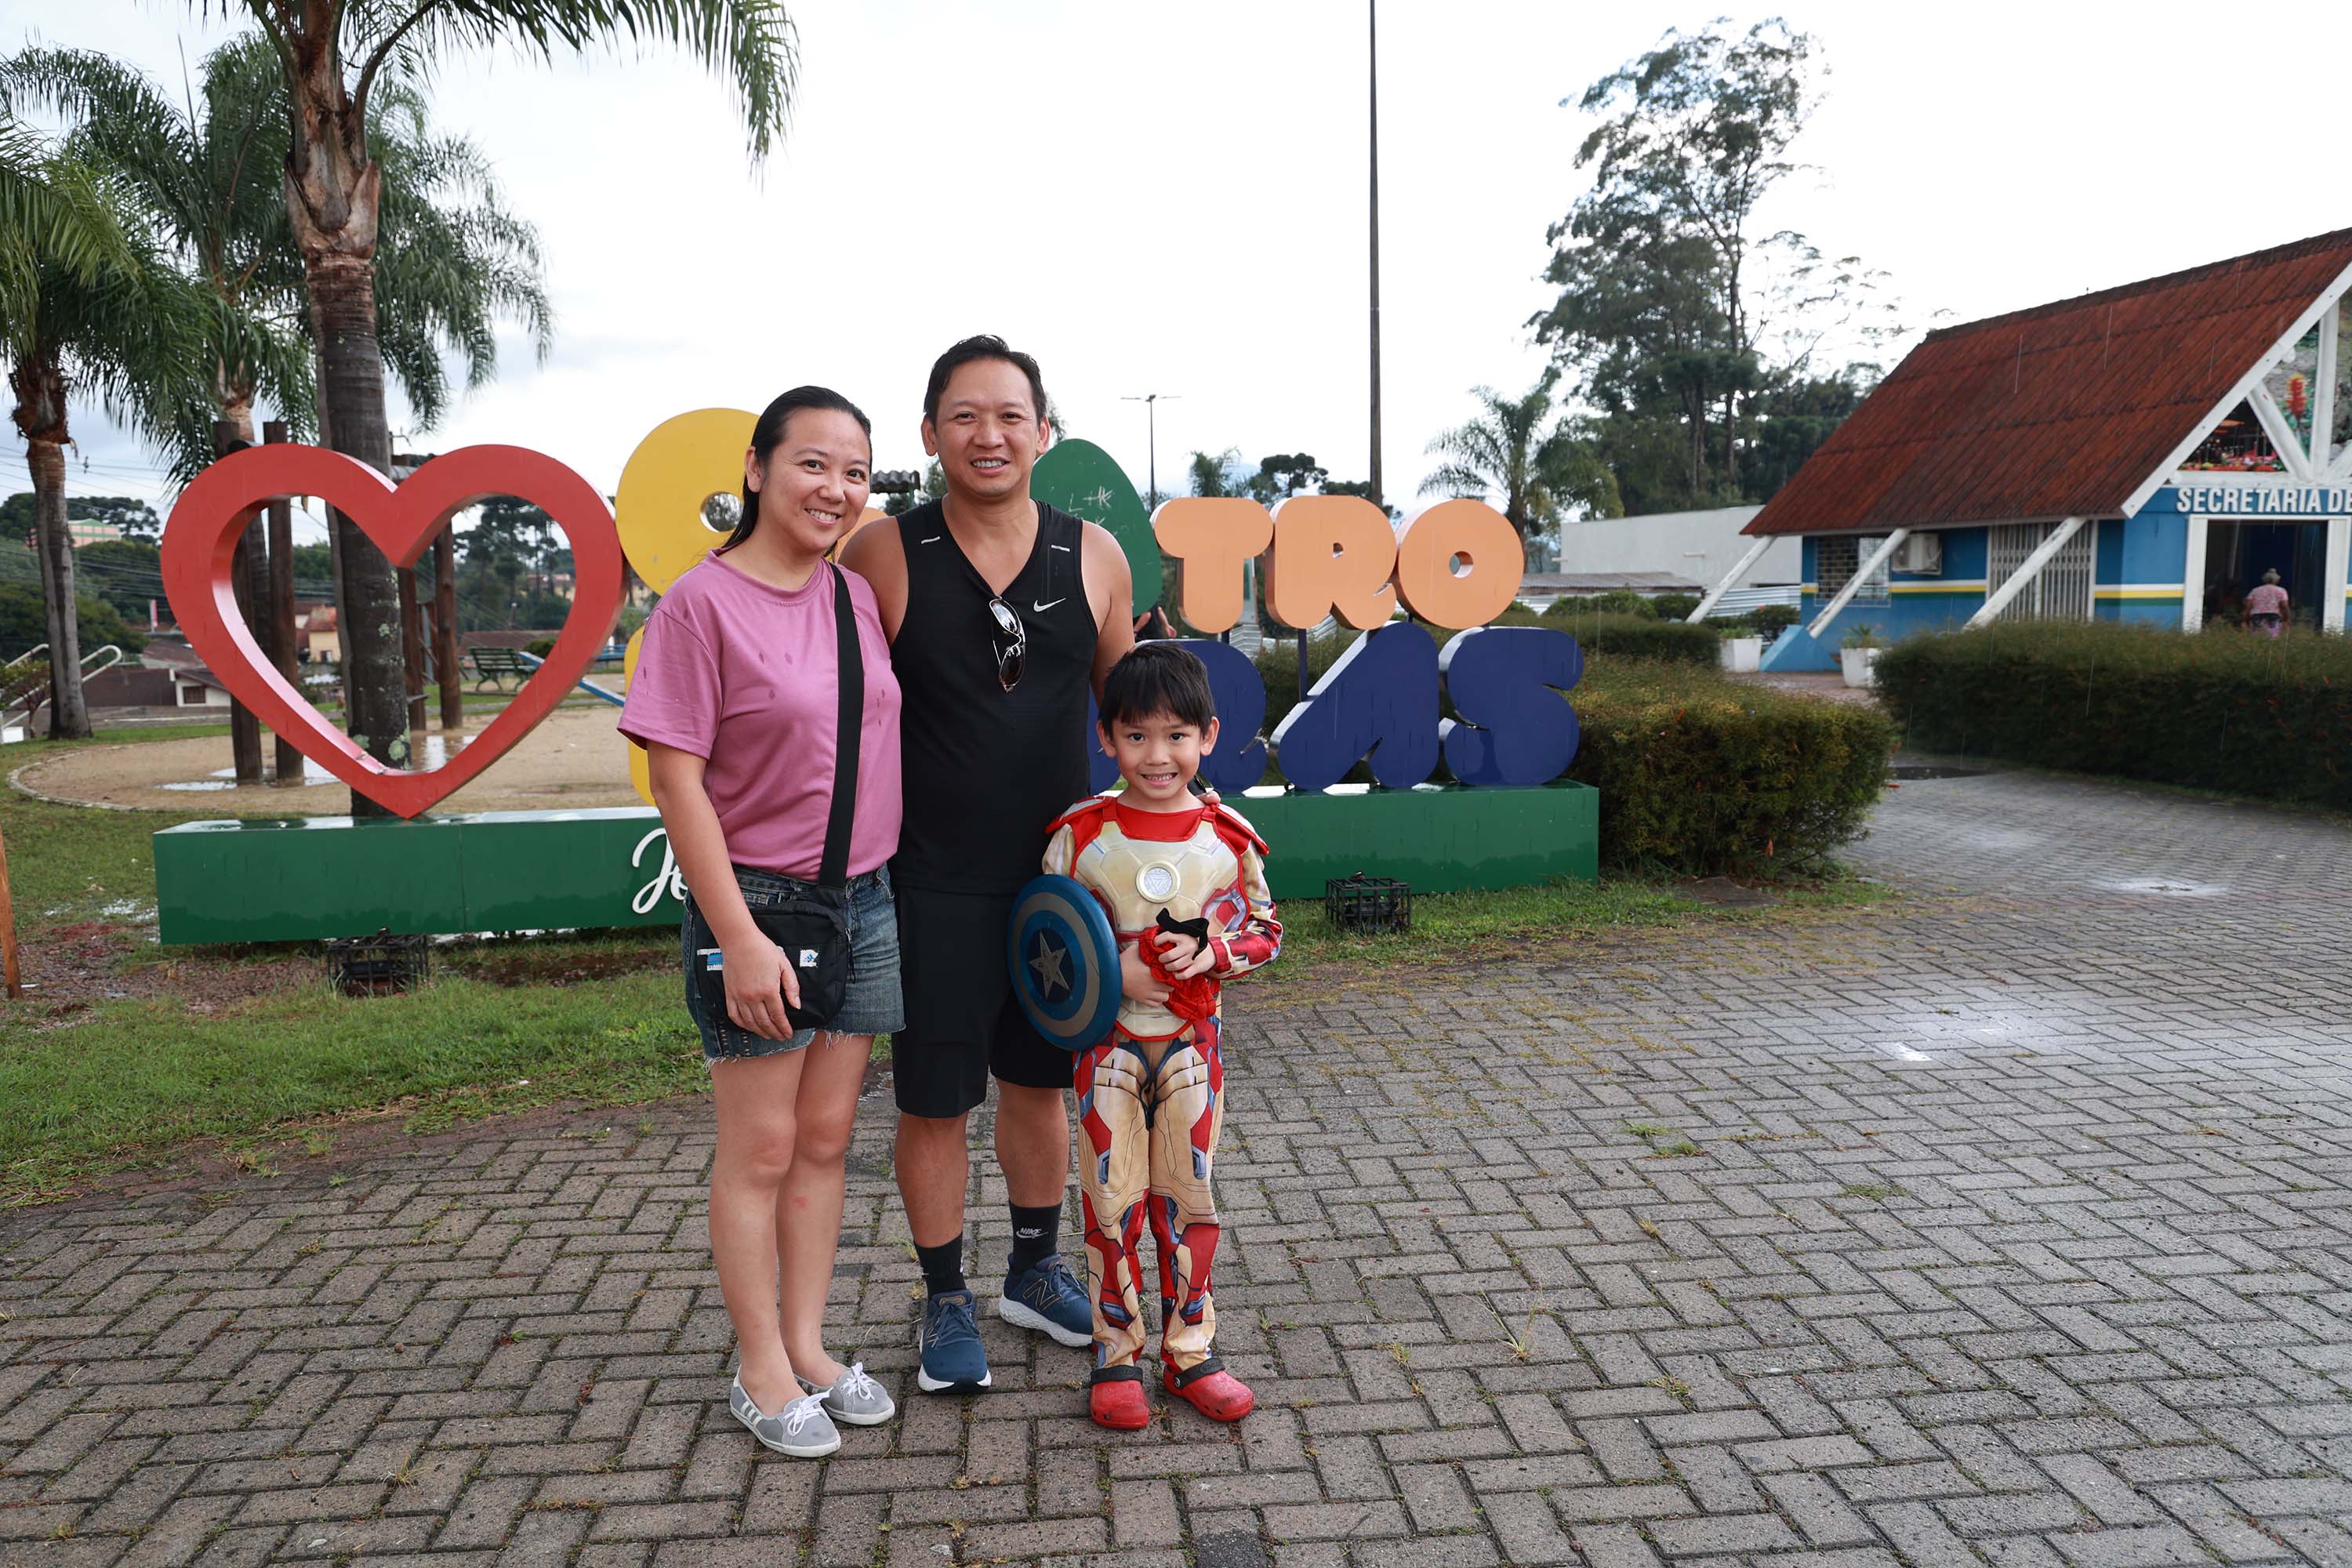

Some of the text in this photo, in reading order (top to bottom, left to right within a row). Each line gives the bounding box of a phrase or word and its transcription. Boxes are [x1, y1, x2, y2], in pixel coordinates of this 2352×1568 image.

[2176, 488, 2352, 513] SECRETARIA DE
[1019, 1227, 1042, 1236] NIKE
